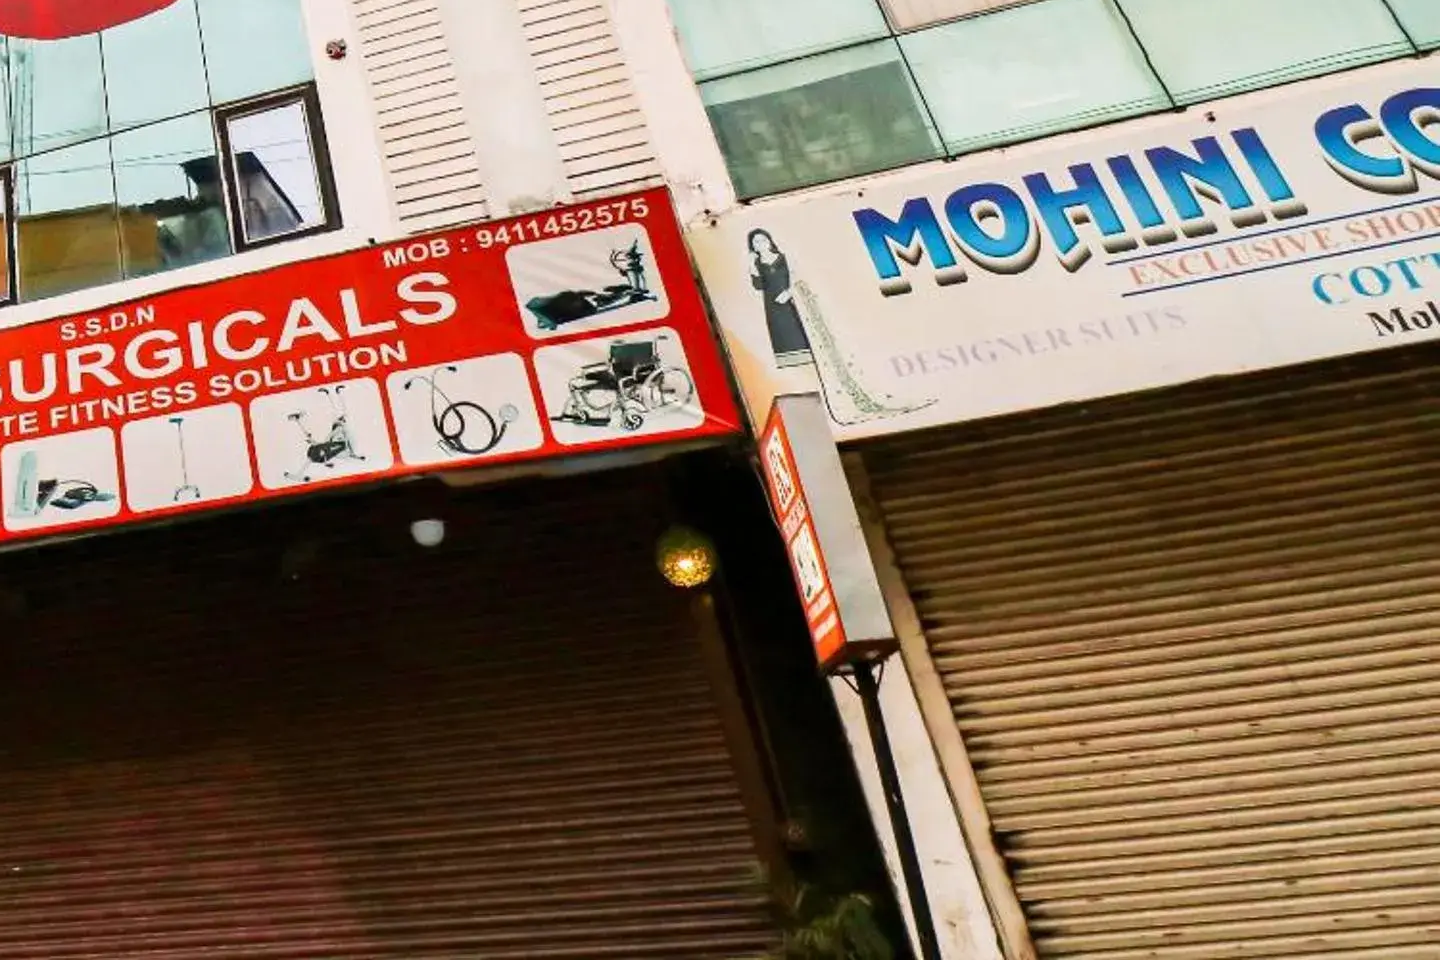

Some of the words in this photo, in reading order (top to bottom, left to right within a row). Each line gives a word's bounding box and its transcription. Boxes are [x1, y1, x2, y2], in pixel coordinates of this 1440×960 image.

[383, 239, 451, 270] MOB
[475, 198, 650, 250] 9411452575
[852, 127, 1304, 295] MOHINI
[1128, 227, 1338, 286] EXCLUSIVE
[60, 305, 155, 341] S.S.D.N
[889, 326, 1073, 379] DESIGNER
[1078, 304, 1188, 341] SUITS
[49, 381, 197, 429] FITNESS
[209, 340, 408, 399] SOLUTION
